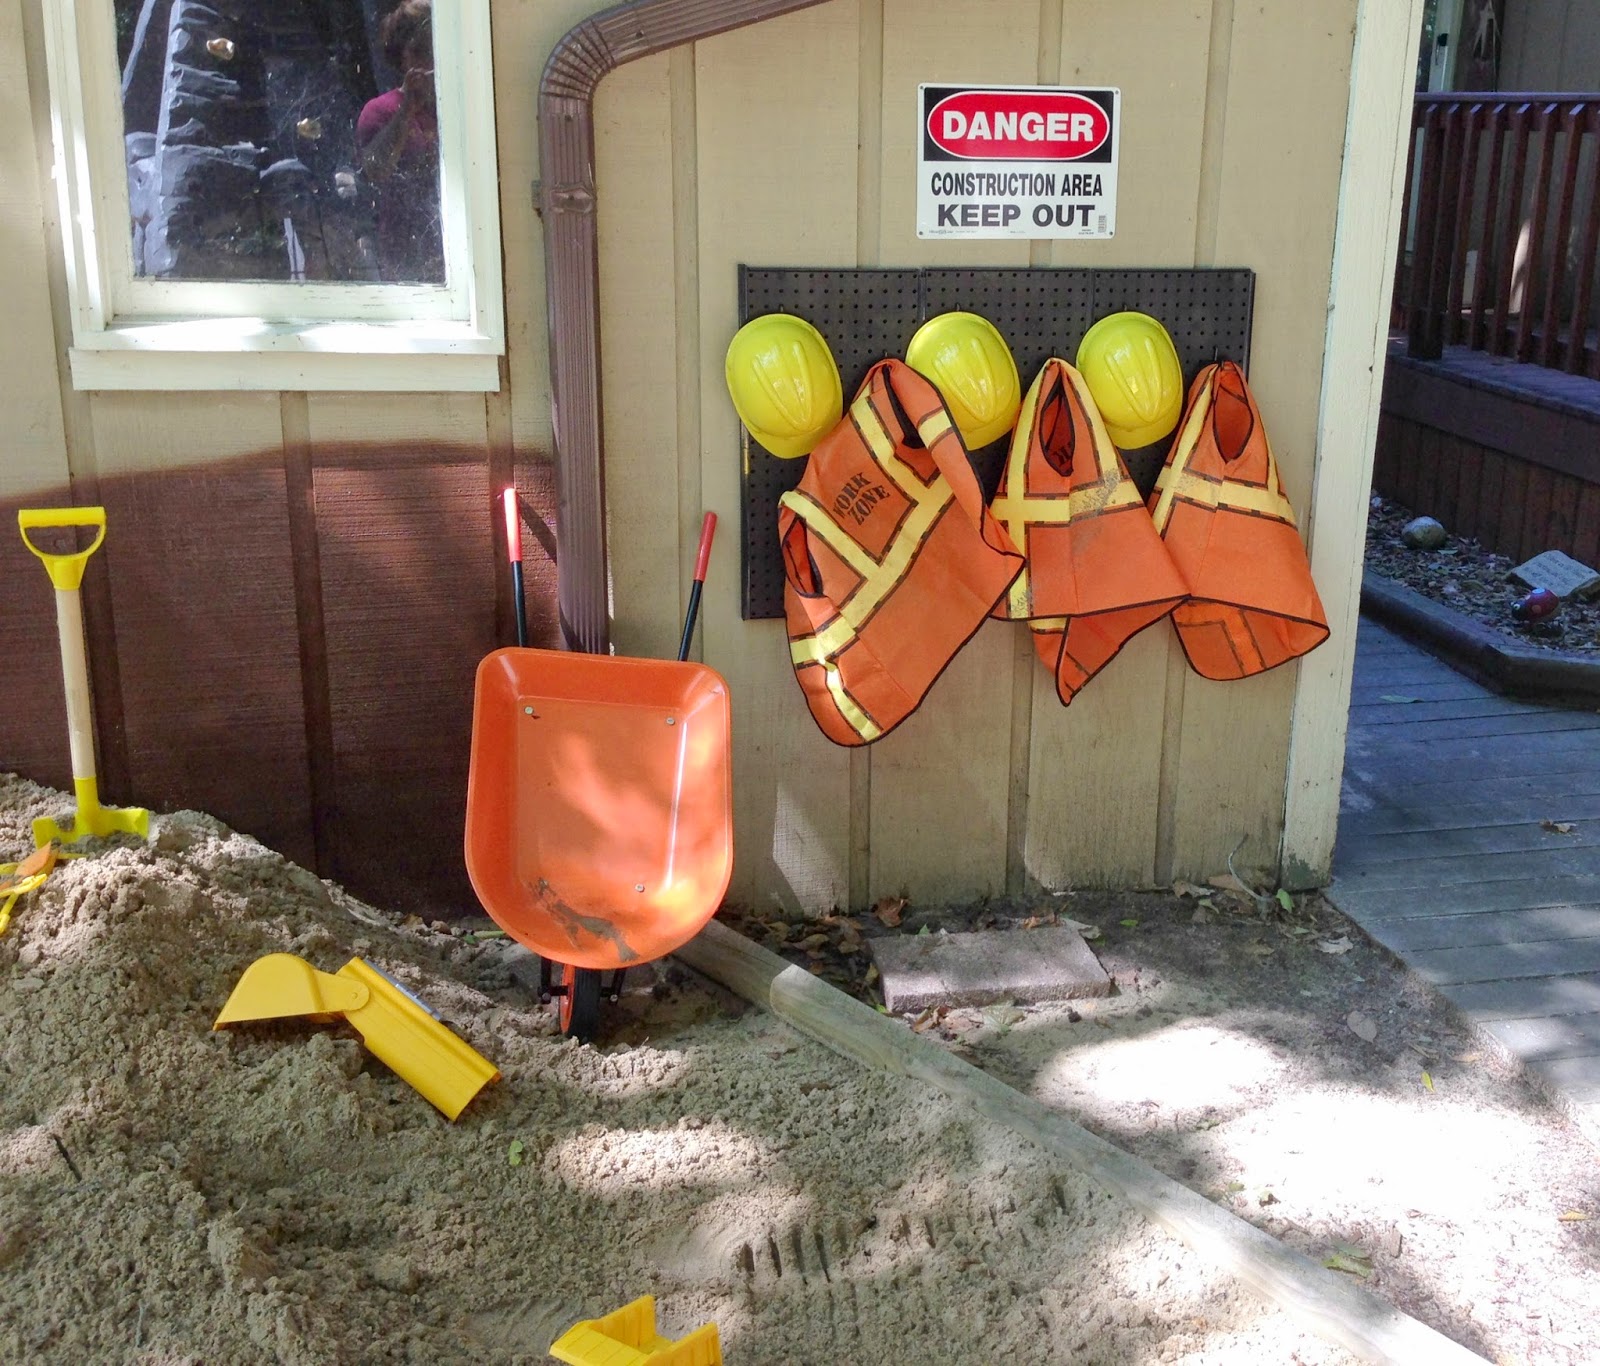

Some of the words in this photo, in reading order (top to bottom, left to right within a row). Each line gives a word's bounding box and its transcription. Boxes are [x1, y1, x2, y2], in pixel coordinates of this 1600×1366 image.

[942, 110, 1094, 142] DANGER
[931, 172, 1056, 196] CONSTRUCTION
[1060, 174, 1103, 197] AREA
[937, 204, 1021, 227] KEEP
[1032, 204, 1095, 227] OUT
[848, 485, 890, 526] ZONE
